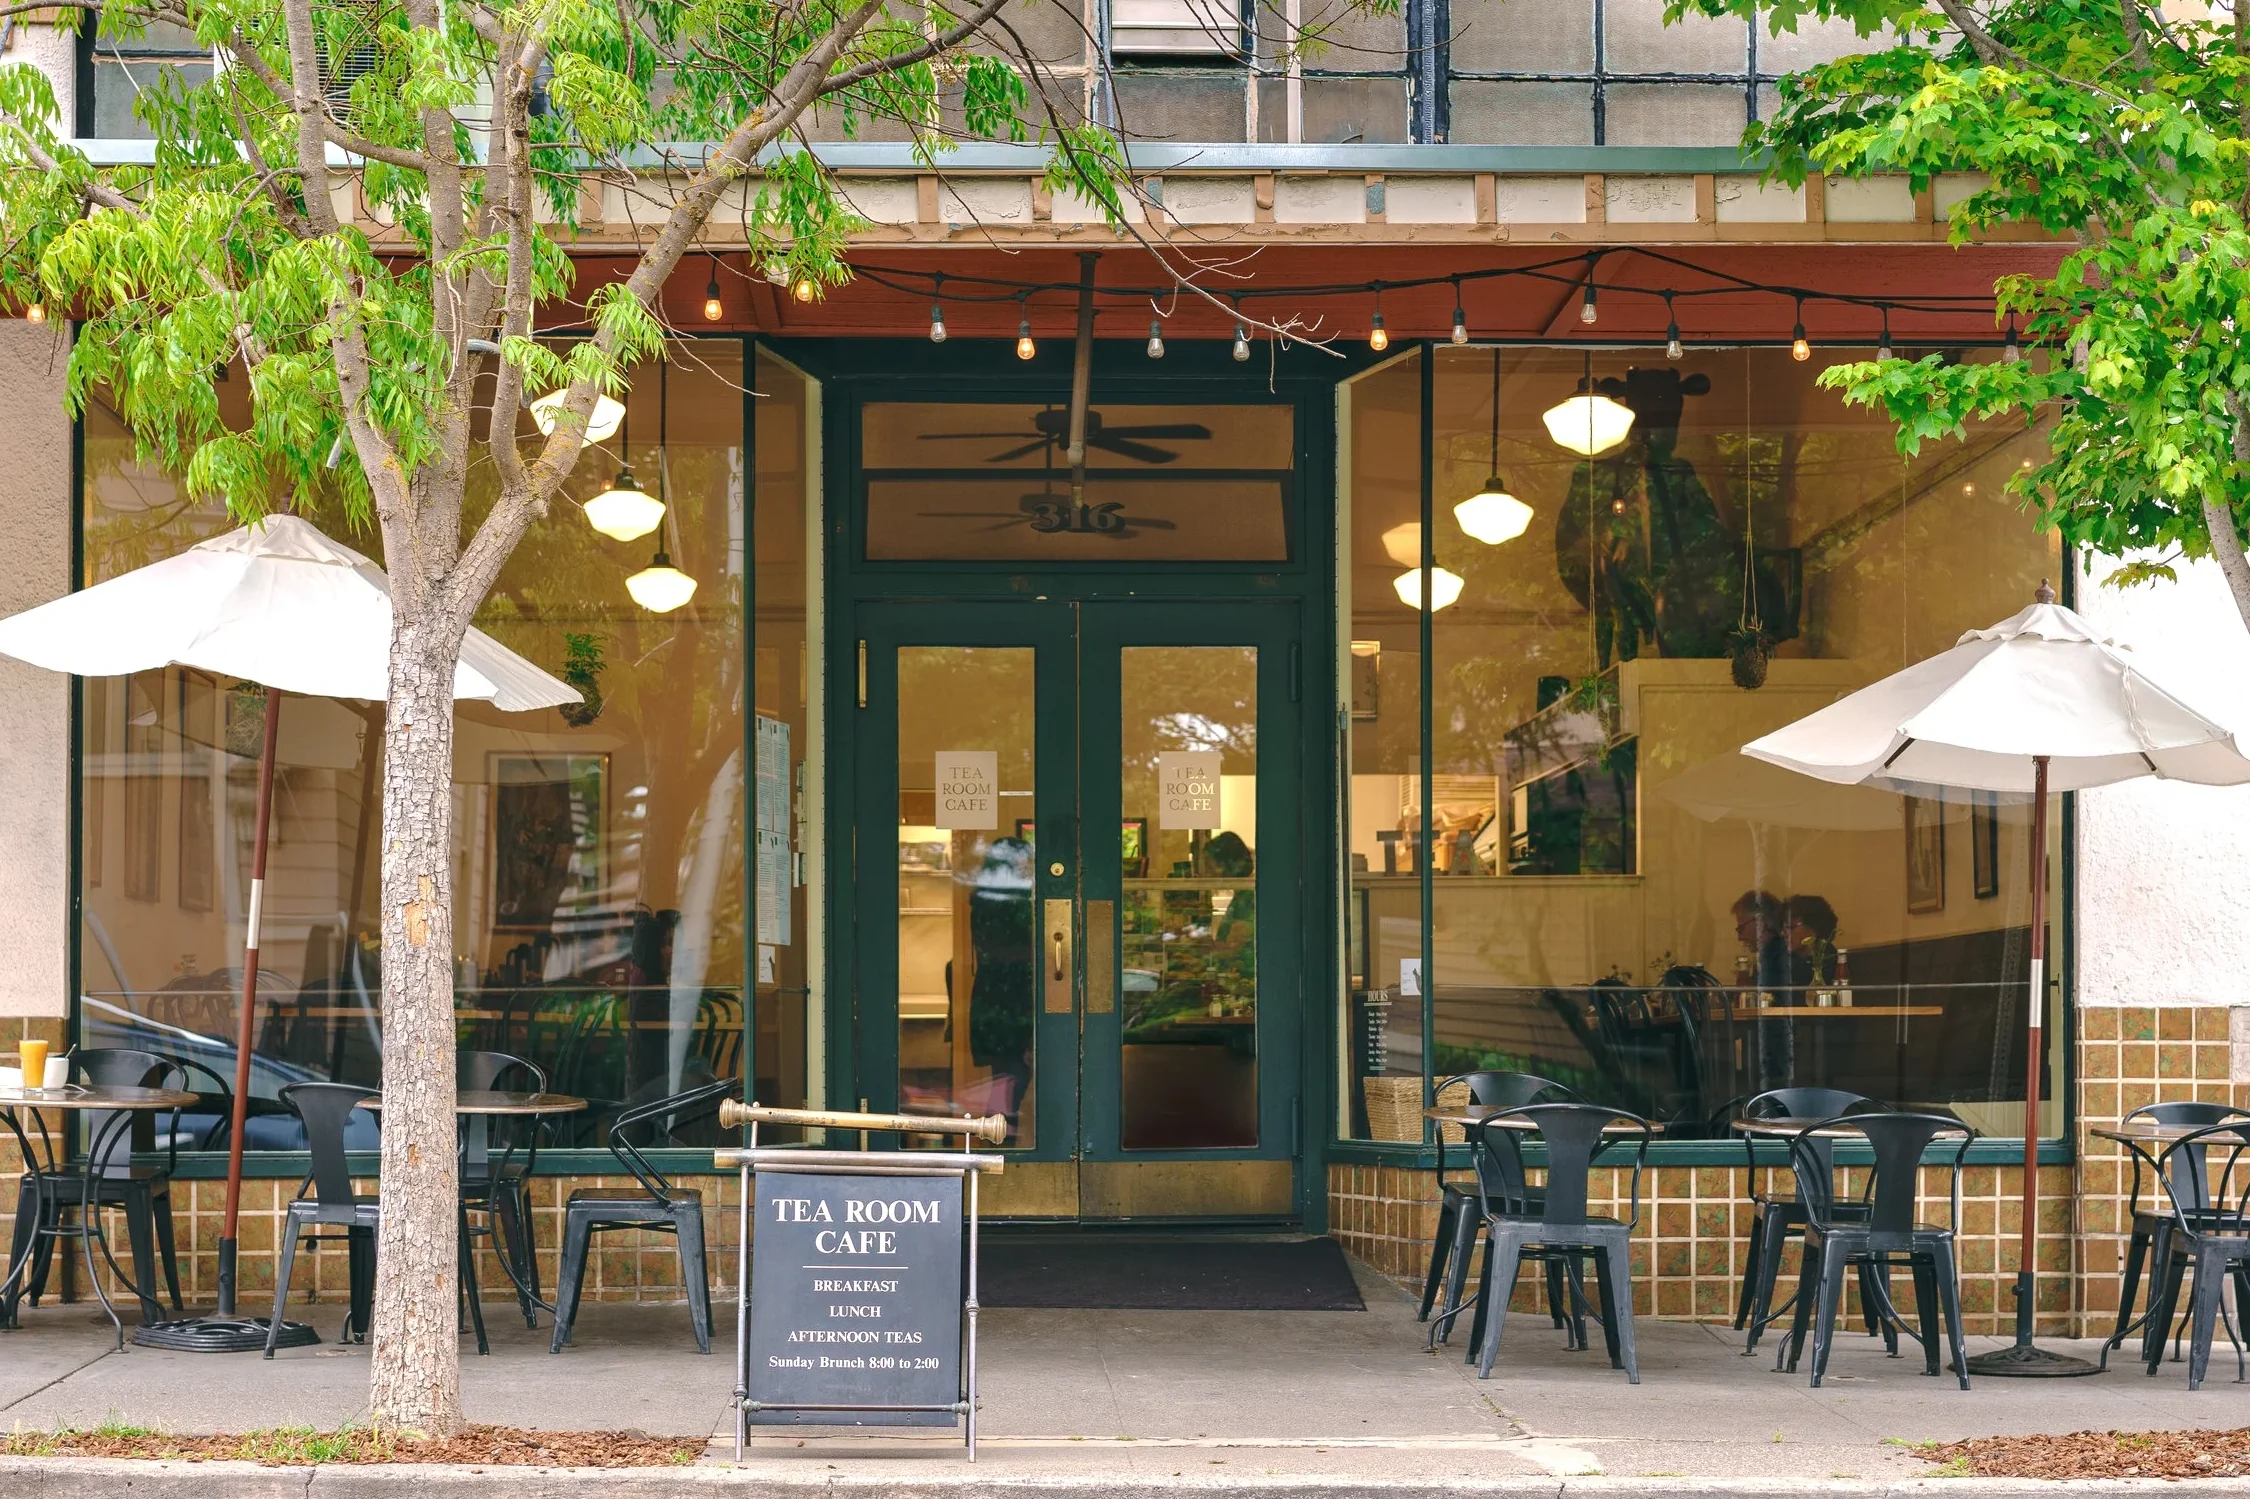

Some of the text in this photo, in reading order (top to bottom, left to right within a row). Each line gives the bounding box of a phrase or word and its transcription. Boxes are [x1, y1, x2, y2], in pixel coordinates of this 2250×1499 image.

[1030, 501, 1126, 533] 316
[949, 766, 983, 779] TEA
[1171, 766, 1207, 779] TEA
[942, 782, 991, 795] ROOM
[1166, 782, 1215, 795] ROOM
[945, 798, 988, 811] CAFE
[1169, 798, 1212, 811] CAFE
[1367, 990, 1389, 1002] HOURS
[771, 1198, 941, 1224] TEA ROOM
[814, 1230, 897, 1255] CAFE
[813, 1279, 899, 1293] BREAKFAST
[829, 1305, 882, 1318] LUNCH
[787, 1330, 923, 1344] AFTERNOON TEAS
[768, 1355, 940, 1371] Sunday Brunch 8:00 to 2:00
